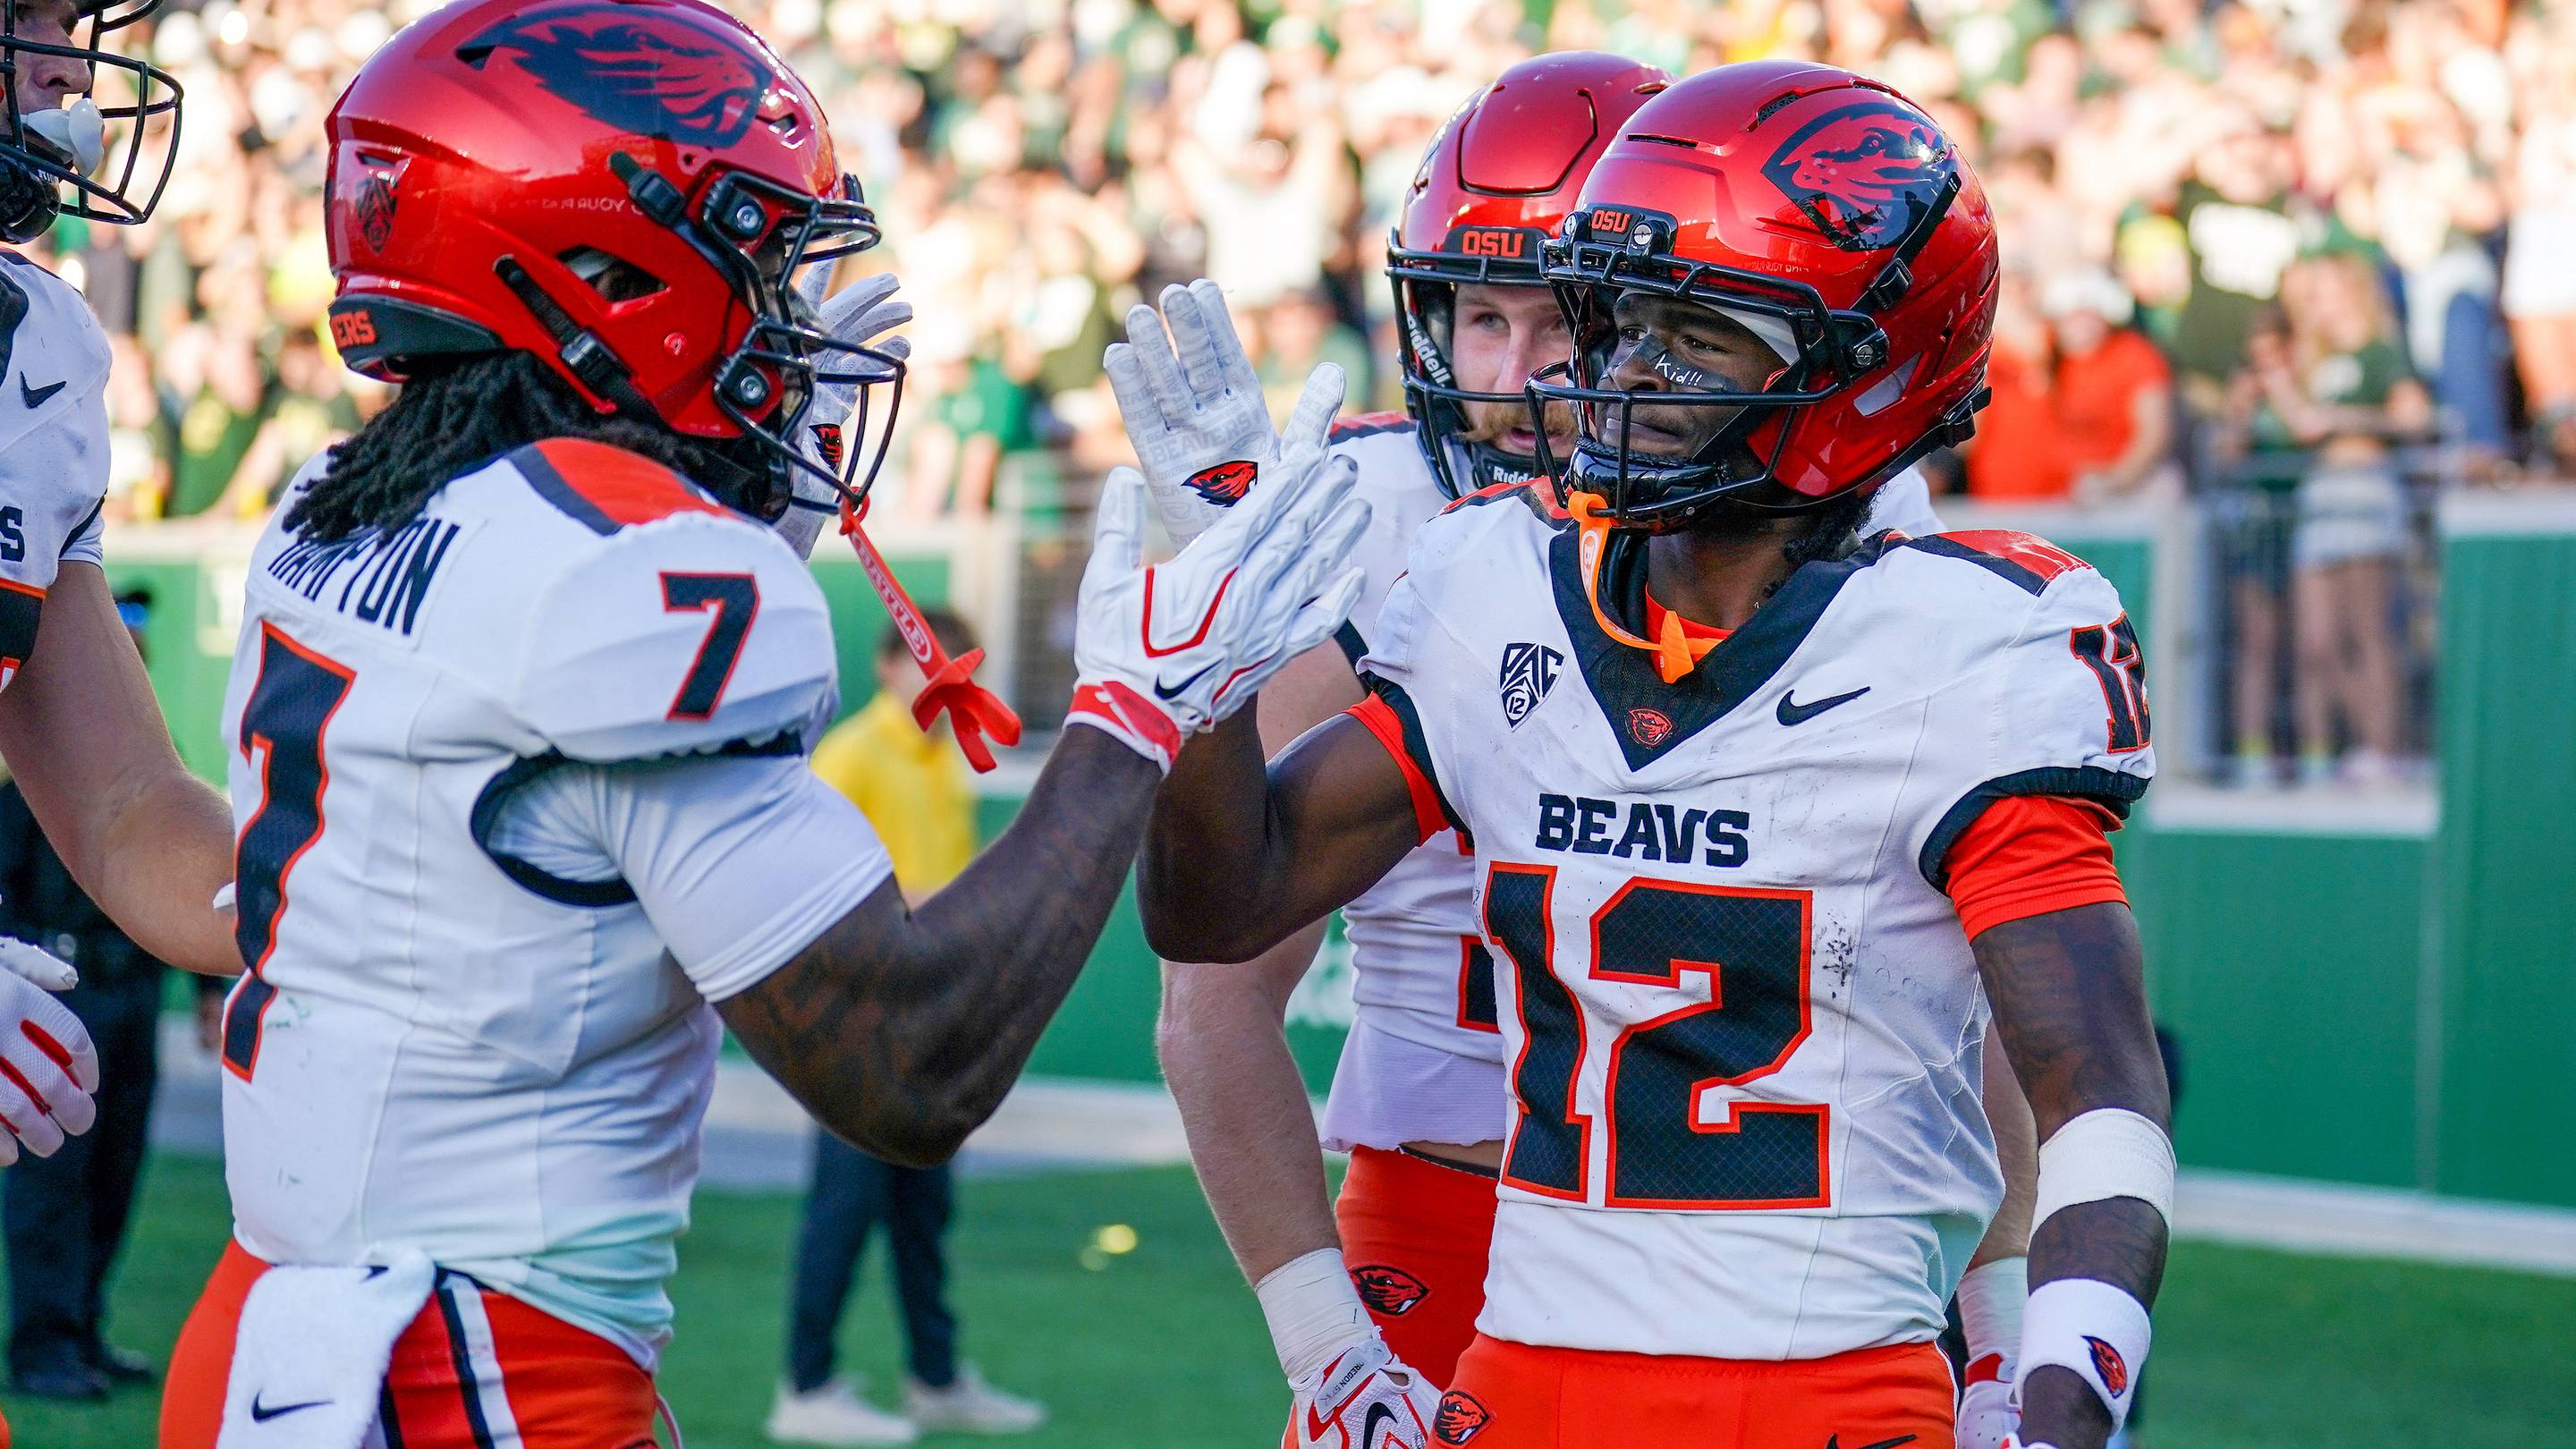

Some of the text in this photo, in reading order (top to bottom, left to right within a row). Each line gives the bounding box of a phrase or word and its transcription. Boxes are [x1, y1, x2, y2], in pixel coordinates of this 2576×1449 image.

[1462, 231, 1523, 258] OSU
[1591, 209, 1632, 233] OSU
[329, 310, 377, 350] ERS
[1655, 353, 1703, 386] Kid!!
[1151, 413, 1252, 465] BEAVERS
[1493, 465, 1535, 485] Ridd
[658, 572, 761, 722] 7
[1499, 642, 1565, 699] PAC
[1508, 696, 1526, 715] 12
[2069, 610, 2152, 754] 12
[221, 618, 358, 1085] 7
[1535, 792, 1750, 868] BEAVS
[1482, 860, 1831, 1208] 12
